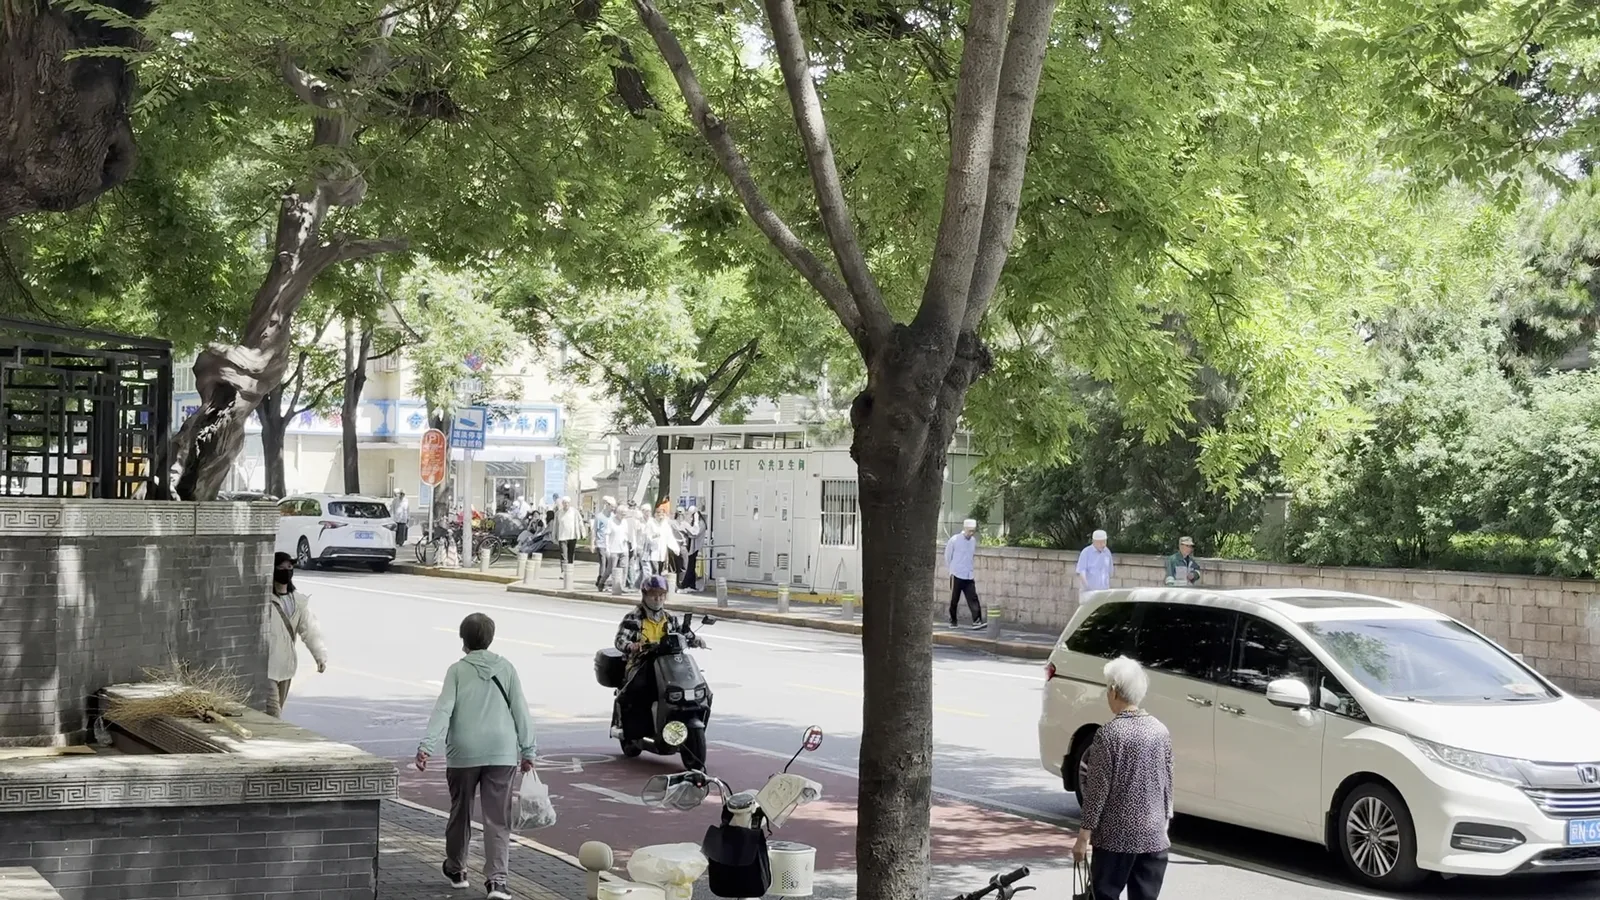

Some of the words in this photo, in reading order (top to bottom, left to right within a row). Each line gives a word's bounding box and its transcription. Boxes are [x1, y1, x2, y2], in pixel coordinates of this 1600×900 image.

[704, 459, 741, 471] TOILET
[757, 459, 805, 471] 公共卫生间
